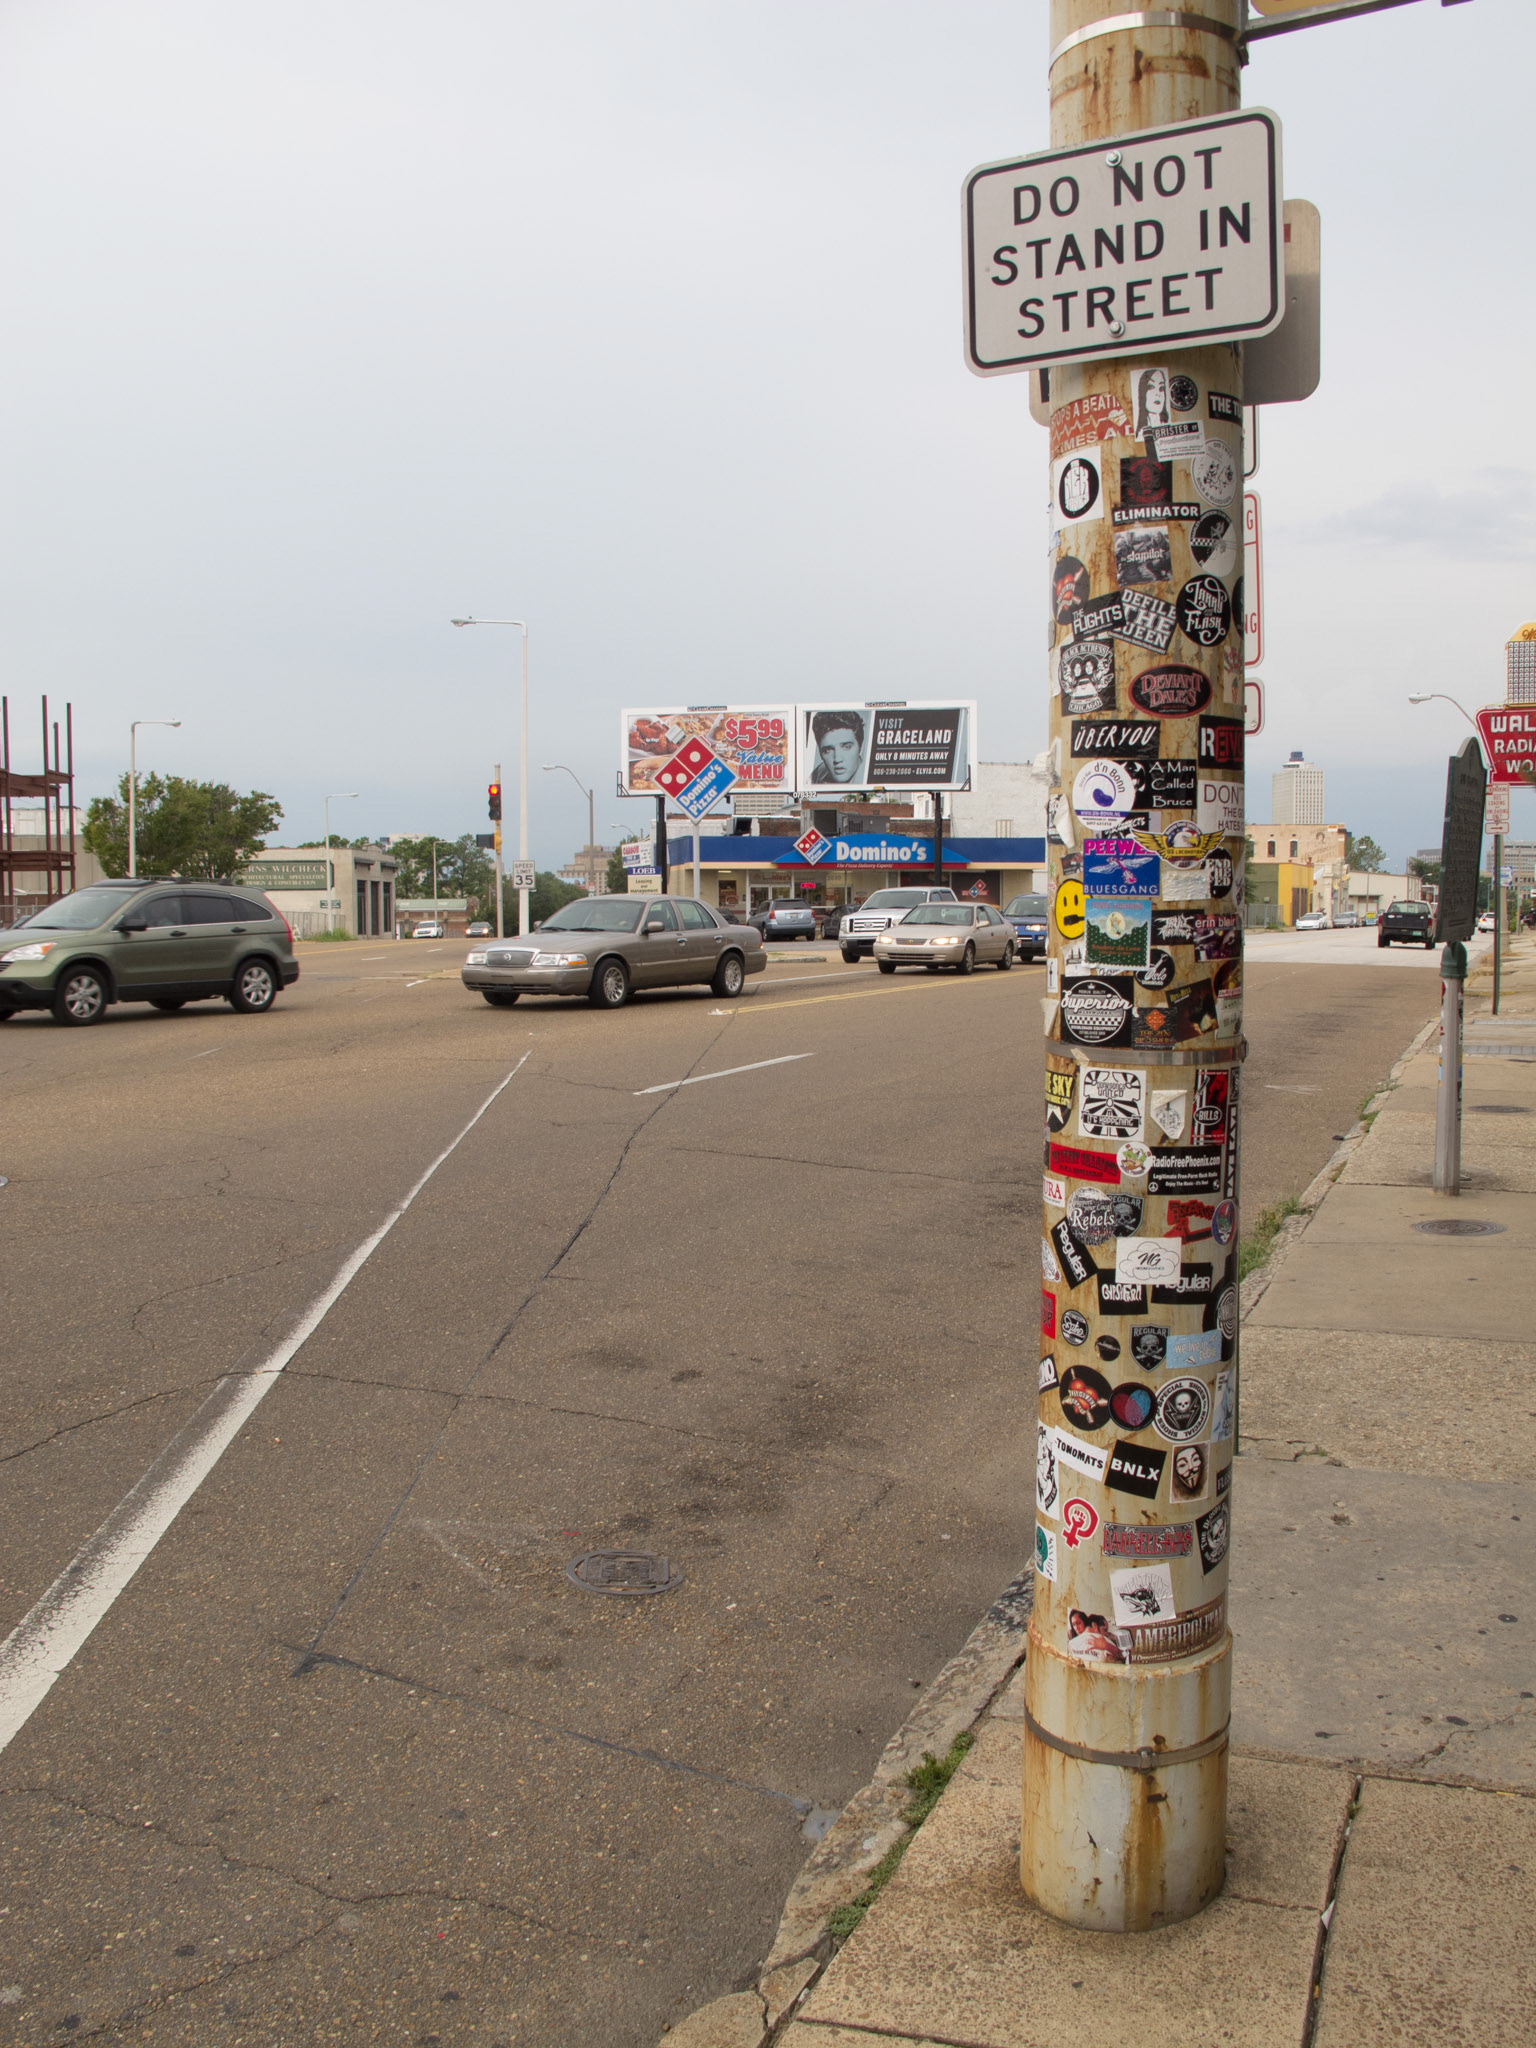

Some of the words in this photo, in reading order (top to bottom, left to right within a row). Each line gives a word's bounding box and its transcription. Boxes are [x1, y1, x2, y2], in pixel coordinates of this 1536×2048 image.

[1013, 175, 1080, 226] DO
[1113, 146, 1222, 207] NOT
[991, 218, 1164, 286] STAND
[1199, 202, 1251, 250] IN
[1017, 267, 1223, 339] STREET
[1209, 395, 1231, 414] THE
[1155, 424, 1189, 438] BRISTER
[1114, 506, 1199, 522] ELIMINATOR
[1121, 589, 1176, 619] DEFILE
[1122, 603, 1175, 635] THE
[1114, 623, 1169, 648] UEEN
[1141, 672, 1202, 694] DEVIANT
[1070, 700, 1100, 711] CHICAGO
[879, 718, 904, 729] VISIT
[876, 729, 952, 745] GRACELAND
[736, 751, 784, 765] Value
[875, 752, 893, 761] ONLY
[899, 752, 928, 761] MINUTES
[929, 751, 949, 760] AWAY
[738, 765, 783, 780] MENU
[915, 767, 946, 775] ELVIS.COM
[1149, 762, 1164, 773] A
[1167, 761, 1196, 773] Man
[1506, 759, 1536, 773] WO
[678, 763, 723, 808] Domino's
[1109, 768, 1125, 793] Bonn
[1151, 778, 1194, 791] Called
[688, 785, 717, 817] Pizza
[1152, 796, 1193, 807] Bruce
[836, 841, 927, 860] Domino's
[515, 875, 533, 886] 35
[1084, 884, 1159, 895] BLUESGANG
[1195, 919, 1216, 928] erin
[1218, 917, 1235, 928] blair
[1061, 990, 1133, 1013] Superior
[1052, 1074, 1073, 1099] SKY
[1199, 1110, 1219, 1121] BILLS
[1152, 1155, 1220, 1168] RadioFreePhoenix.com
[1070, 1208, 1115, 1230] Rebels
[1133, 1327, 1167, 1337] REGULAR
[1158, 1382, 1183, 1405] SPECIAL
[1189, 1382, 1206, 1400] SHOES
[1159, 1417, 1179, 1438] SHOES
[1055, 1437, 1104, 1469] TONOMATS
[1110, 1457, 1160, 1481] BNLX
